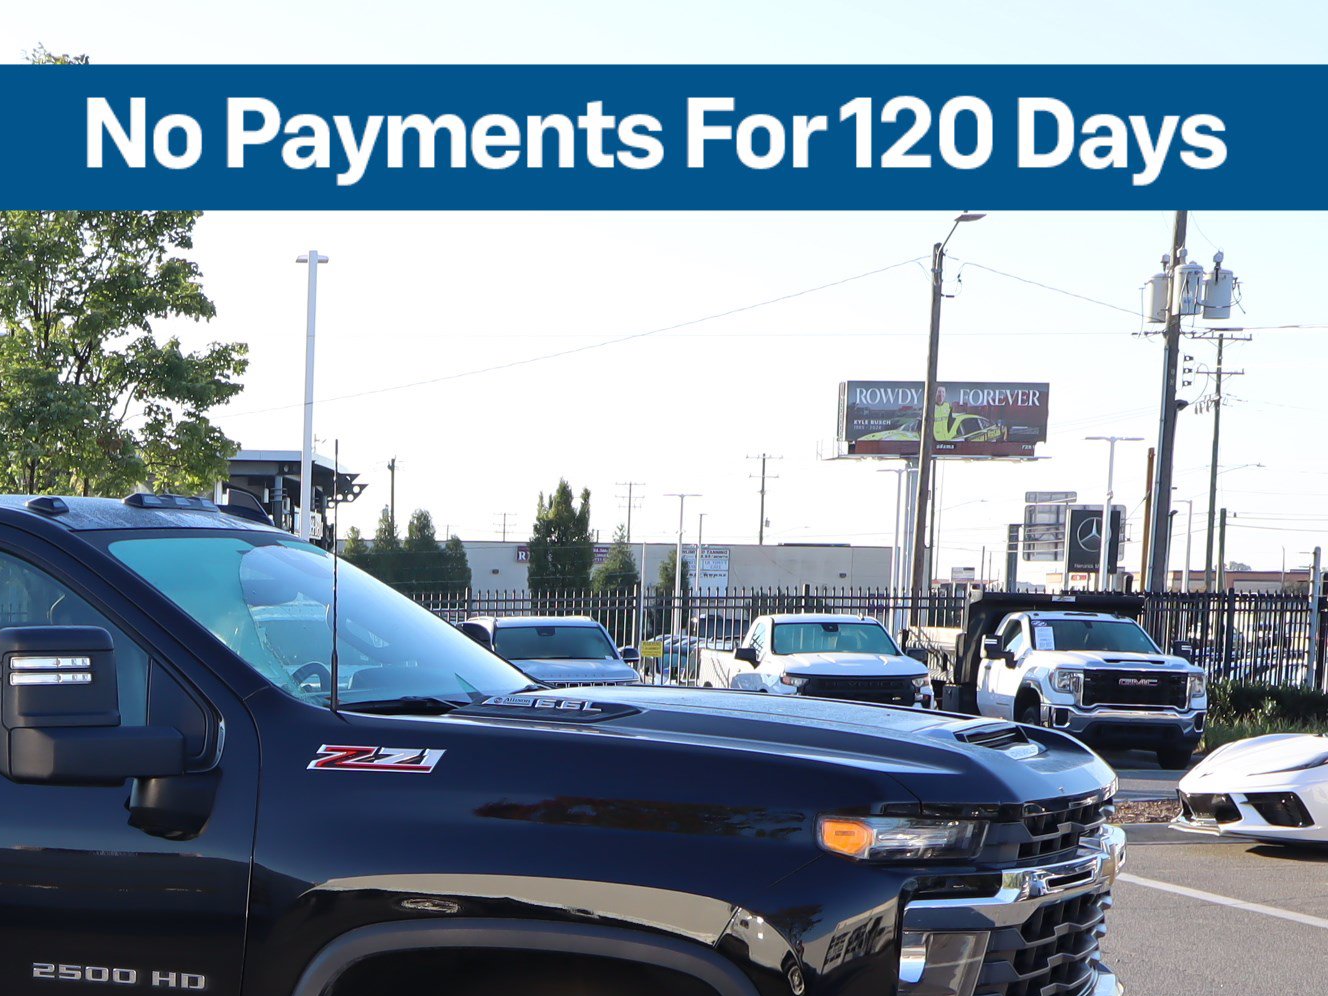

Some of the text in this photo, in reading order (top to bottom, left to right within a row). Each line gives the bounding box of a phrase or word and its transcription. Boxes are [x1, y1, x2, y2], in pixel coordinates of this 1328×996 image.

[856, 387, 1040, 407] ROWDY FOREVER
[1118, 678, 1158, 686] GMC
[306, 744, 447, 774] Z71
[32, 962, 206, 990] 2500 HD
